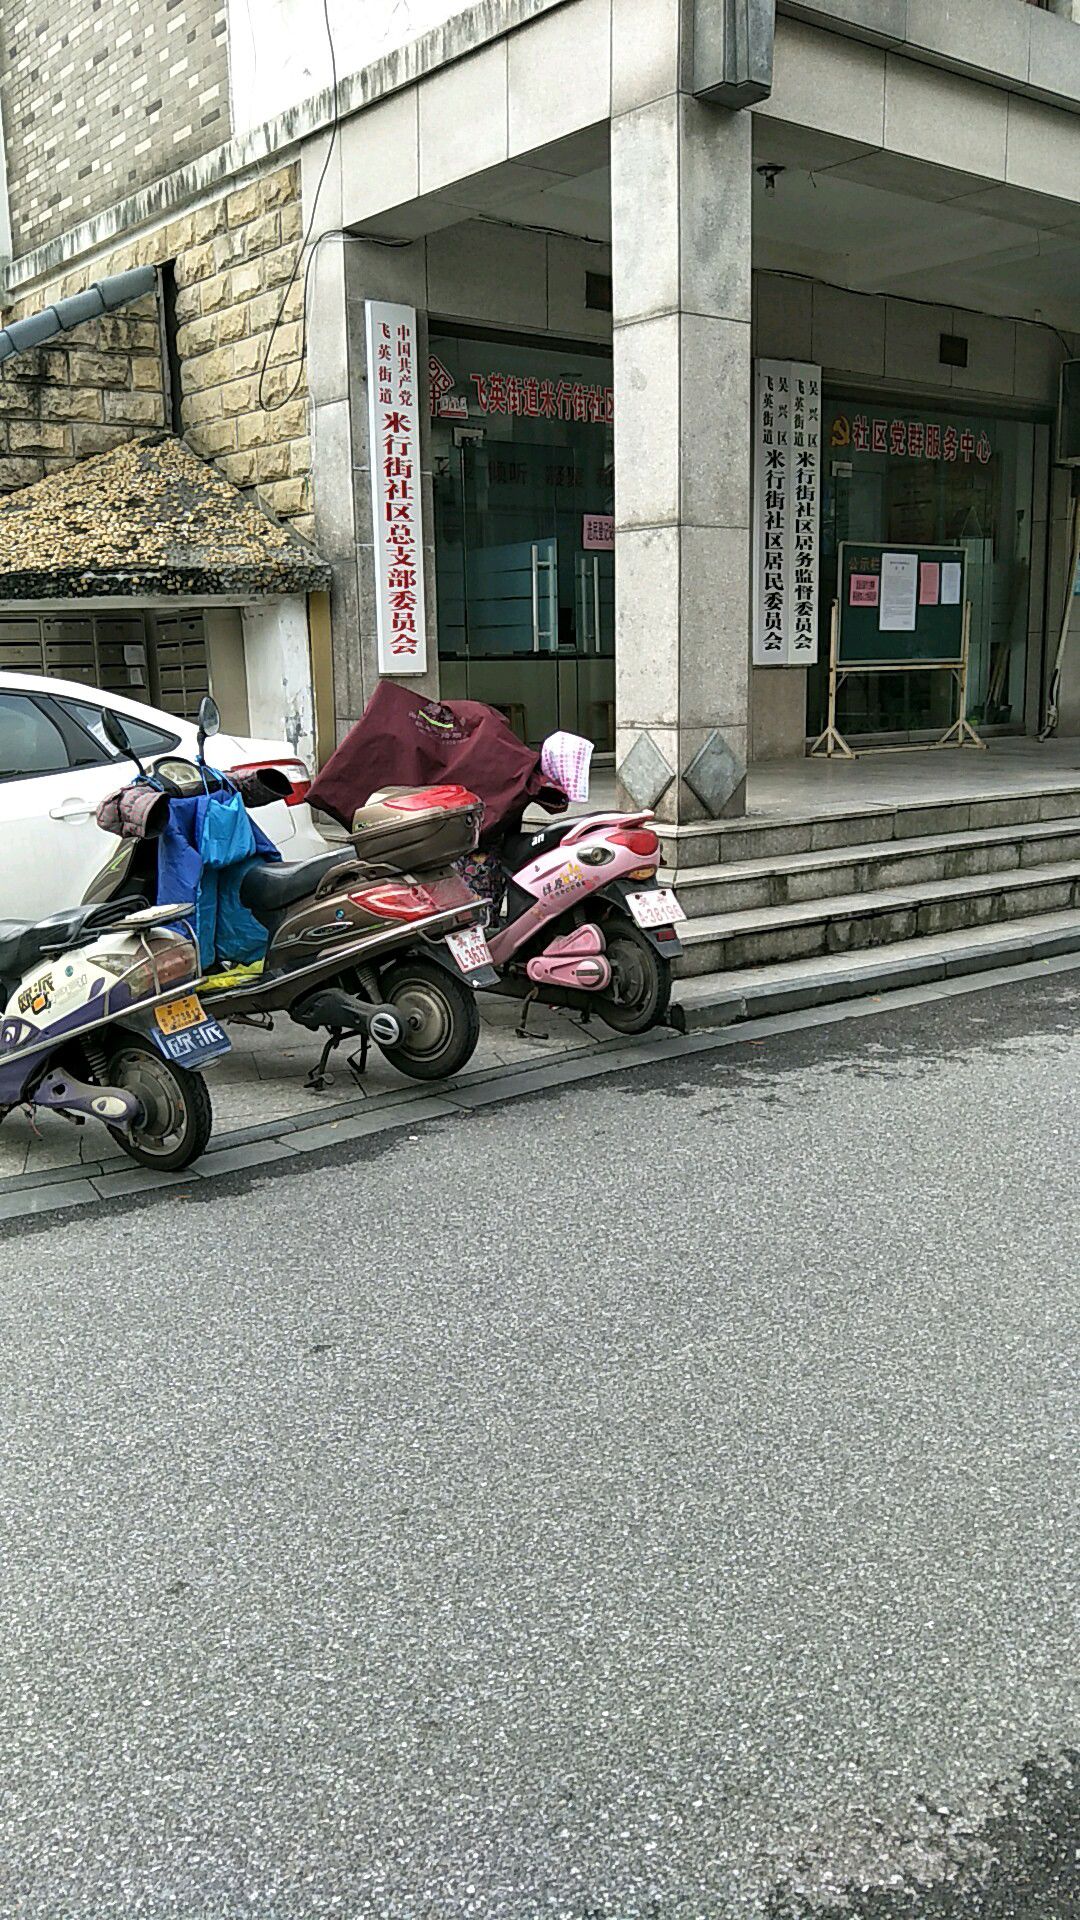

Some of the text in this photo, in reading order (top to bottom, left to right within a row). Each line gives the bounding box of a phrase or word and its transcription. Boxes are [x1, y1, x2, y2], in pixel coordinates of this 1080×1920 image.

[377, 322, 393, 405] 飞英街道
[397, 324, 413, 407] 中国共产党
[762, 375, 774, 445] 飞英街道
[777, 376, 788, 446] 吴兴区
[793, 379, 805, 447] 飞英街道
[808, 380, 818, 447] 吴兴区
[852, 414, 992, 464] 社区党群服务中心
[382, 411, 419, 655] 米行街社区总支部委员会
[764, 449, 786, 650] 米行街社区居民委员会
[794, 451, 816, 650] 米行街社区居务监督委员会
